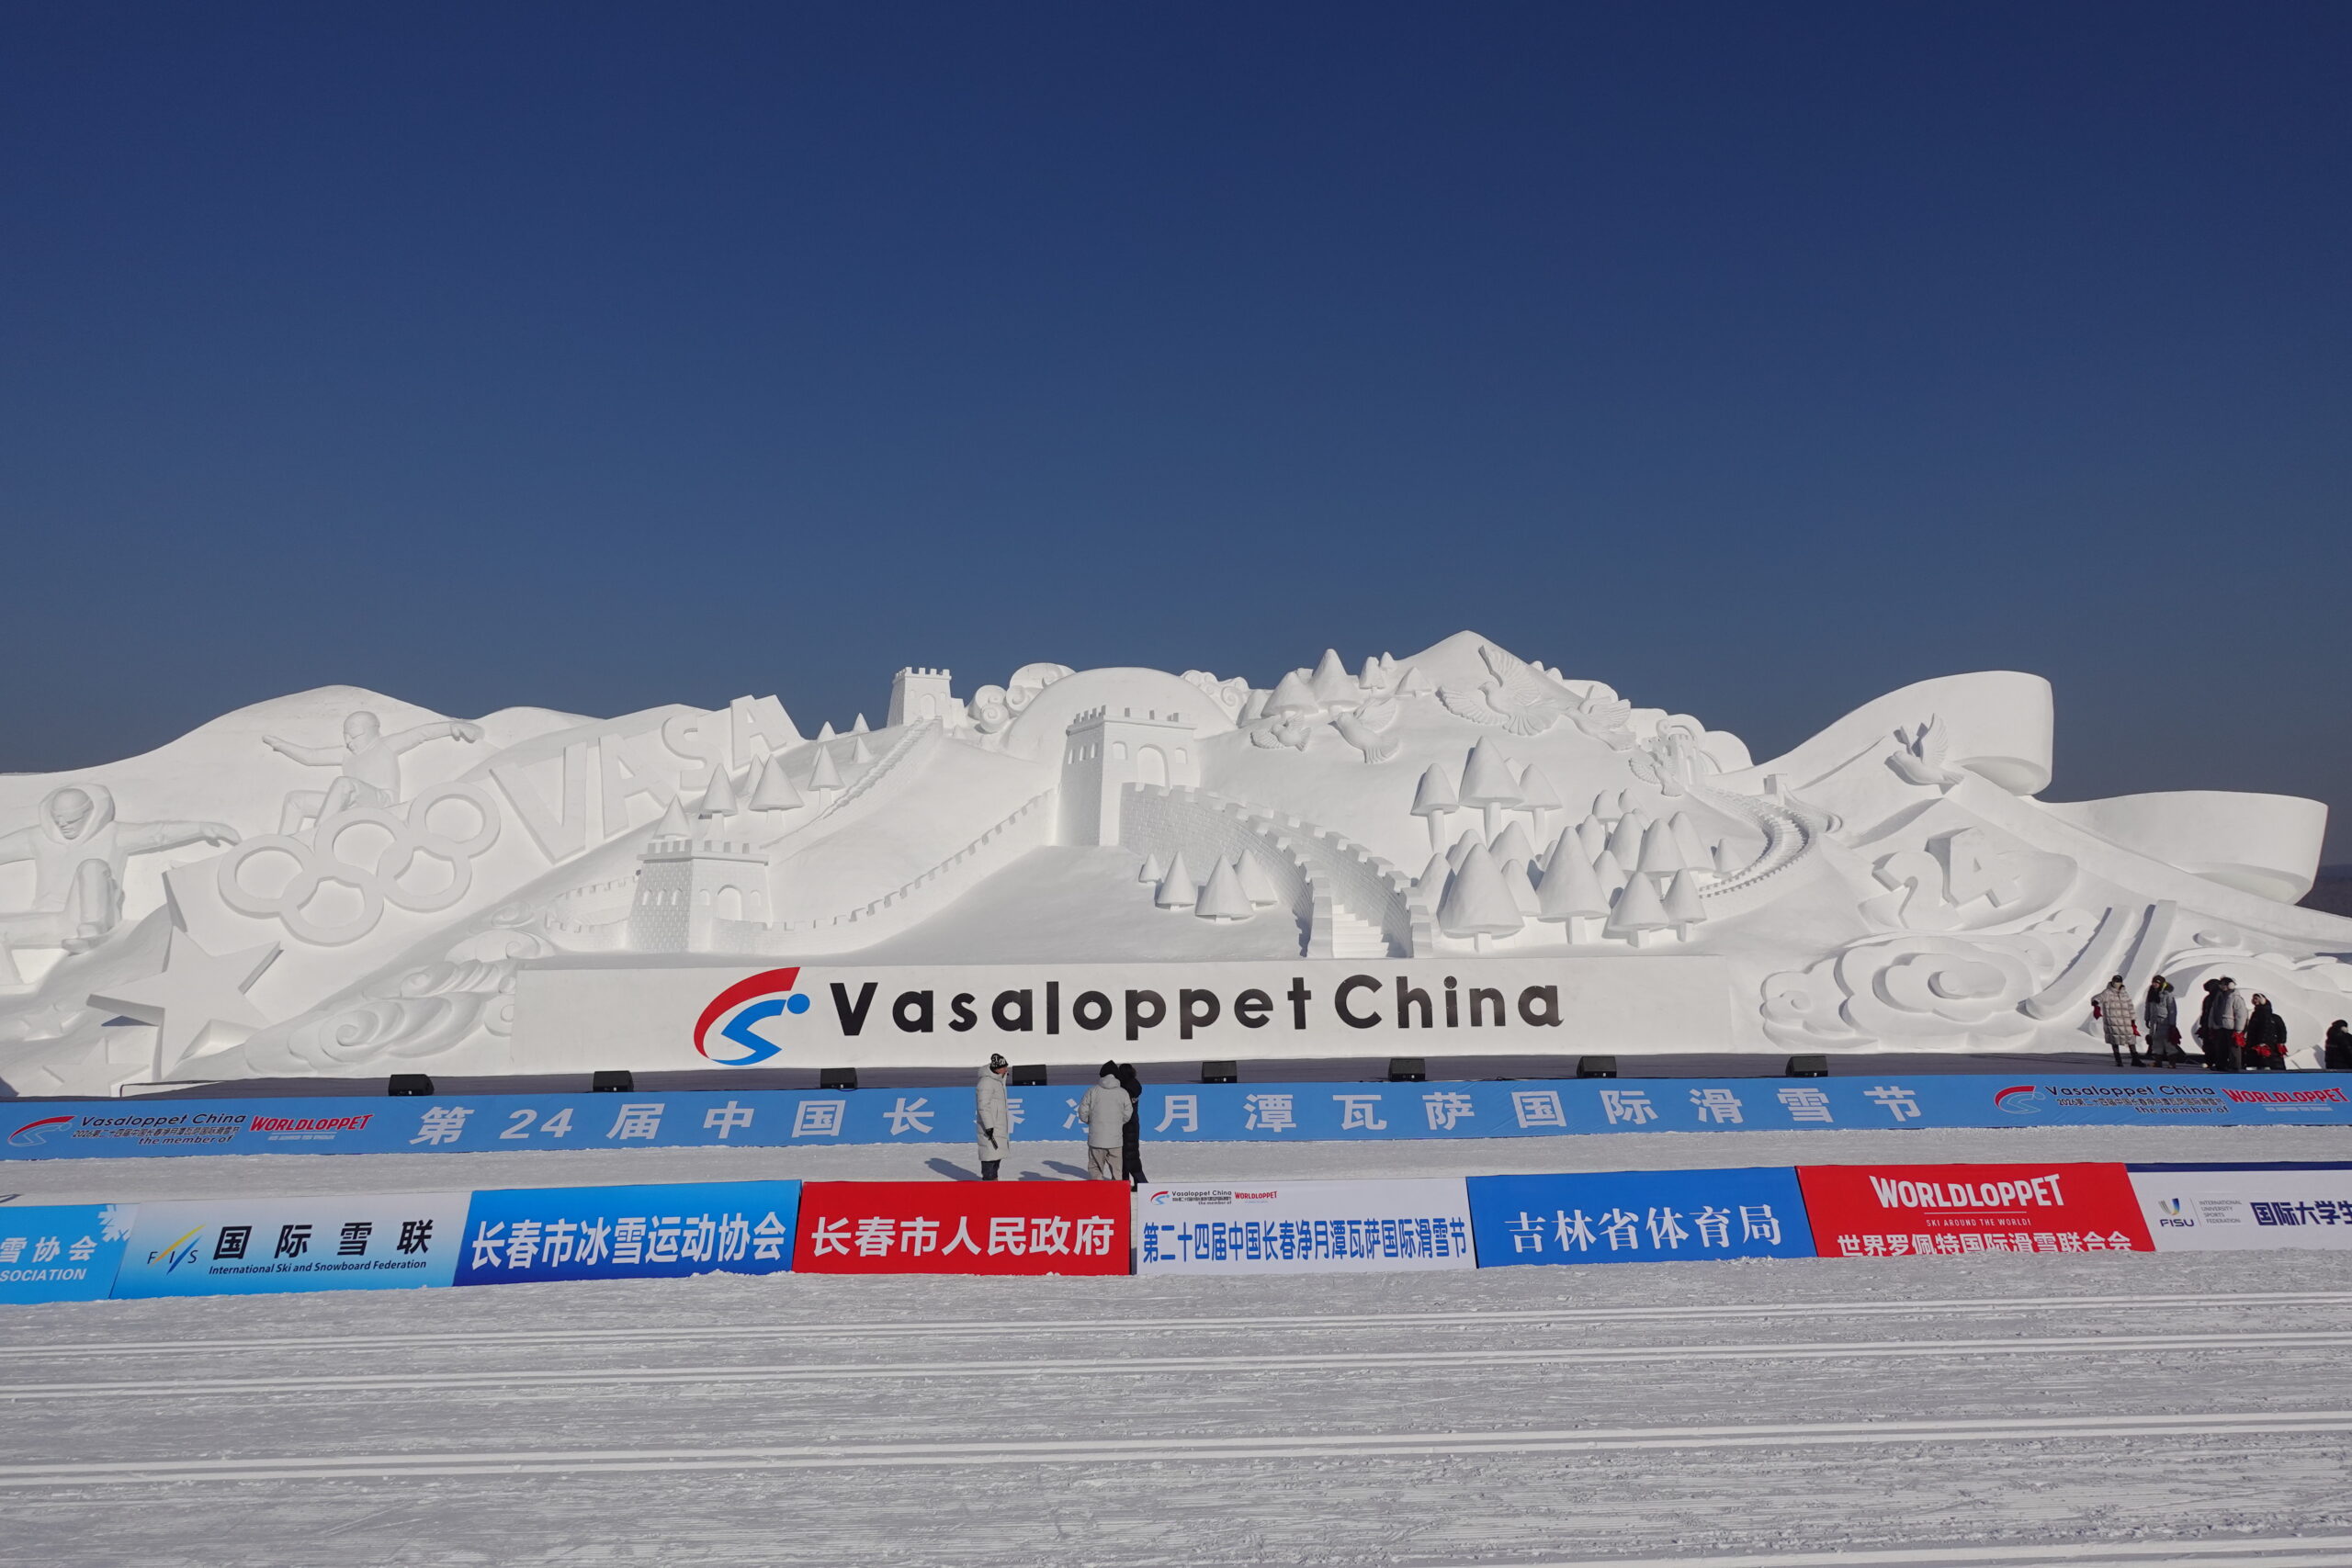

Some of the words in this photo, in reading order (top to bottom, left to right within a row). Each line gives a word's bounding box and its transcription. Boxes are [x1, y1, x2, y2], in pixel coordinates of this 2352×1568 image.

[489, 695, 787, 865] VASA
[1865, 829, 2021, 930] 24
[830, 976, 1311, 1041] Vasaloppet
[1334, 975, 1565, 1029] China
[2044, 1086, 2154, 1098] Vasaloppet
[2157, 1085, 2216, 1096] China
[2222, 1088, 2349, 1103] WORLDLOPPET
[2135, 1105, 2158, 1113] the
[2160, 1105, 2212, 1113] member
[2218, 1105, 2230, 1113] of
[82, 1114, 189, 1128] Vasaloppet
[192, 1112, 247, 1125] China
[249, 1114, 374, 1132] WORLDLOPPET
[139, 1137, 159, 1145] the
[162, 1135, 216, 1145] member
[220, 1134, 233, 1143] of
[1235, 1190, 1278, 1200] WORLDLOPPET
[1869, 1174, 2065, 1209] WORLDLOPPET
[1504, 1203, 1781, 1253] 吉林省体育局
[1926, 1219, 1940, 1227] SKI
[1979, 1218, 1996, 1226] THE
[2160, 1218, 2195, 1227] FISU
[212, 1219, 434, 1260] 国际雪联
[471, 1212, 786, 1270] 长春市冰雪运动协会
[811, 1215, 1114, 1257] 长春市人民政府
[1143, 1217, 1466, 1263] 第二十四届中国长春净月潭瓦萨国际滑雪节
[0, 1235, 97, 1263] 雪协会
[147, 1249, 198, 1264] FIS
[209, 1263, 274, 1275] International
[276, 1263, 292, 1272] Ski
[293, 1262, 312, 1272] and
[314, 1260, 371, 1271] Snowboard
[373, 1258, 426, 1269] Federation
